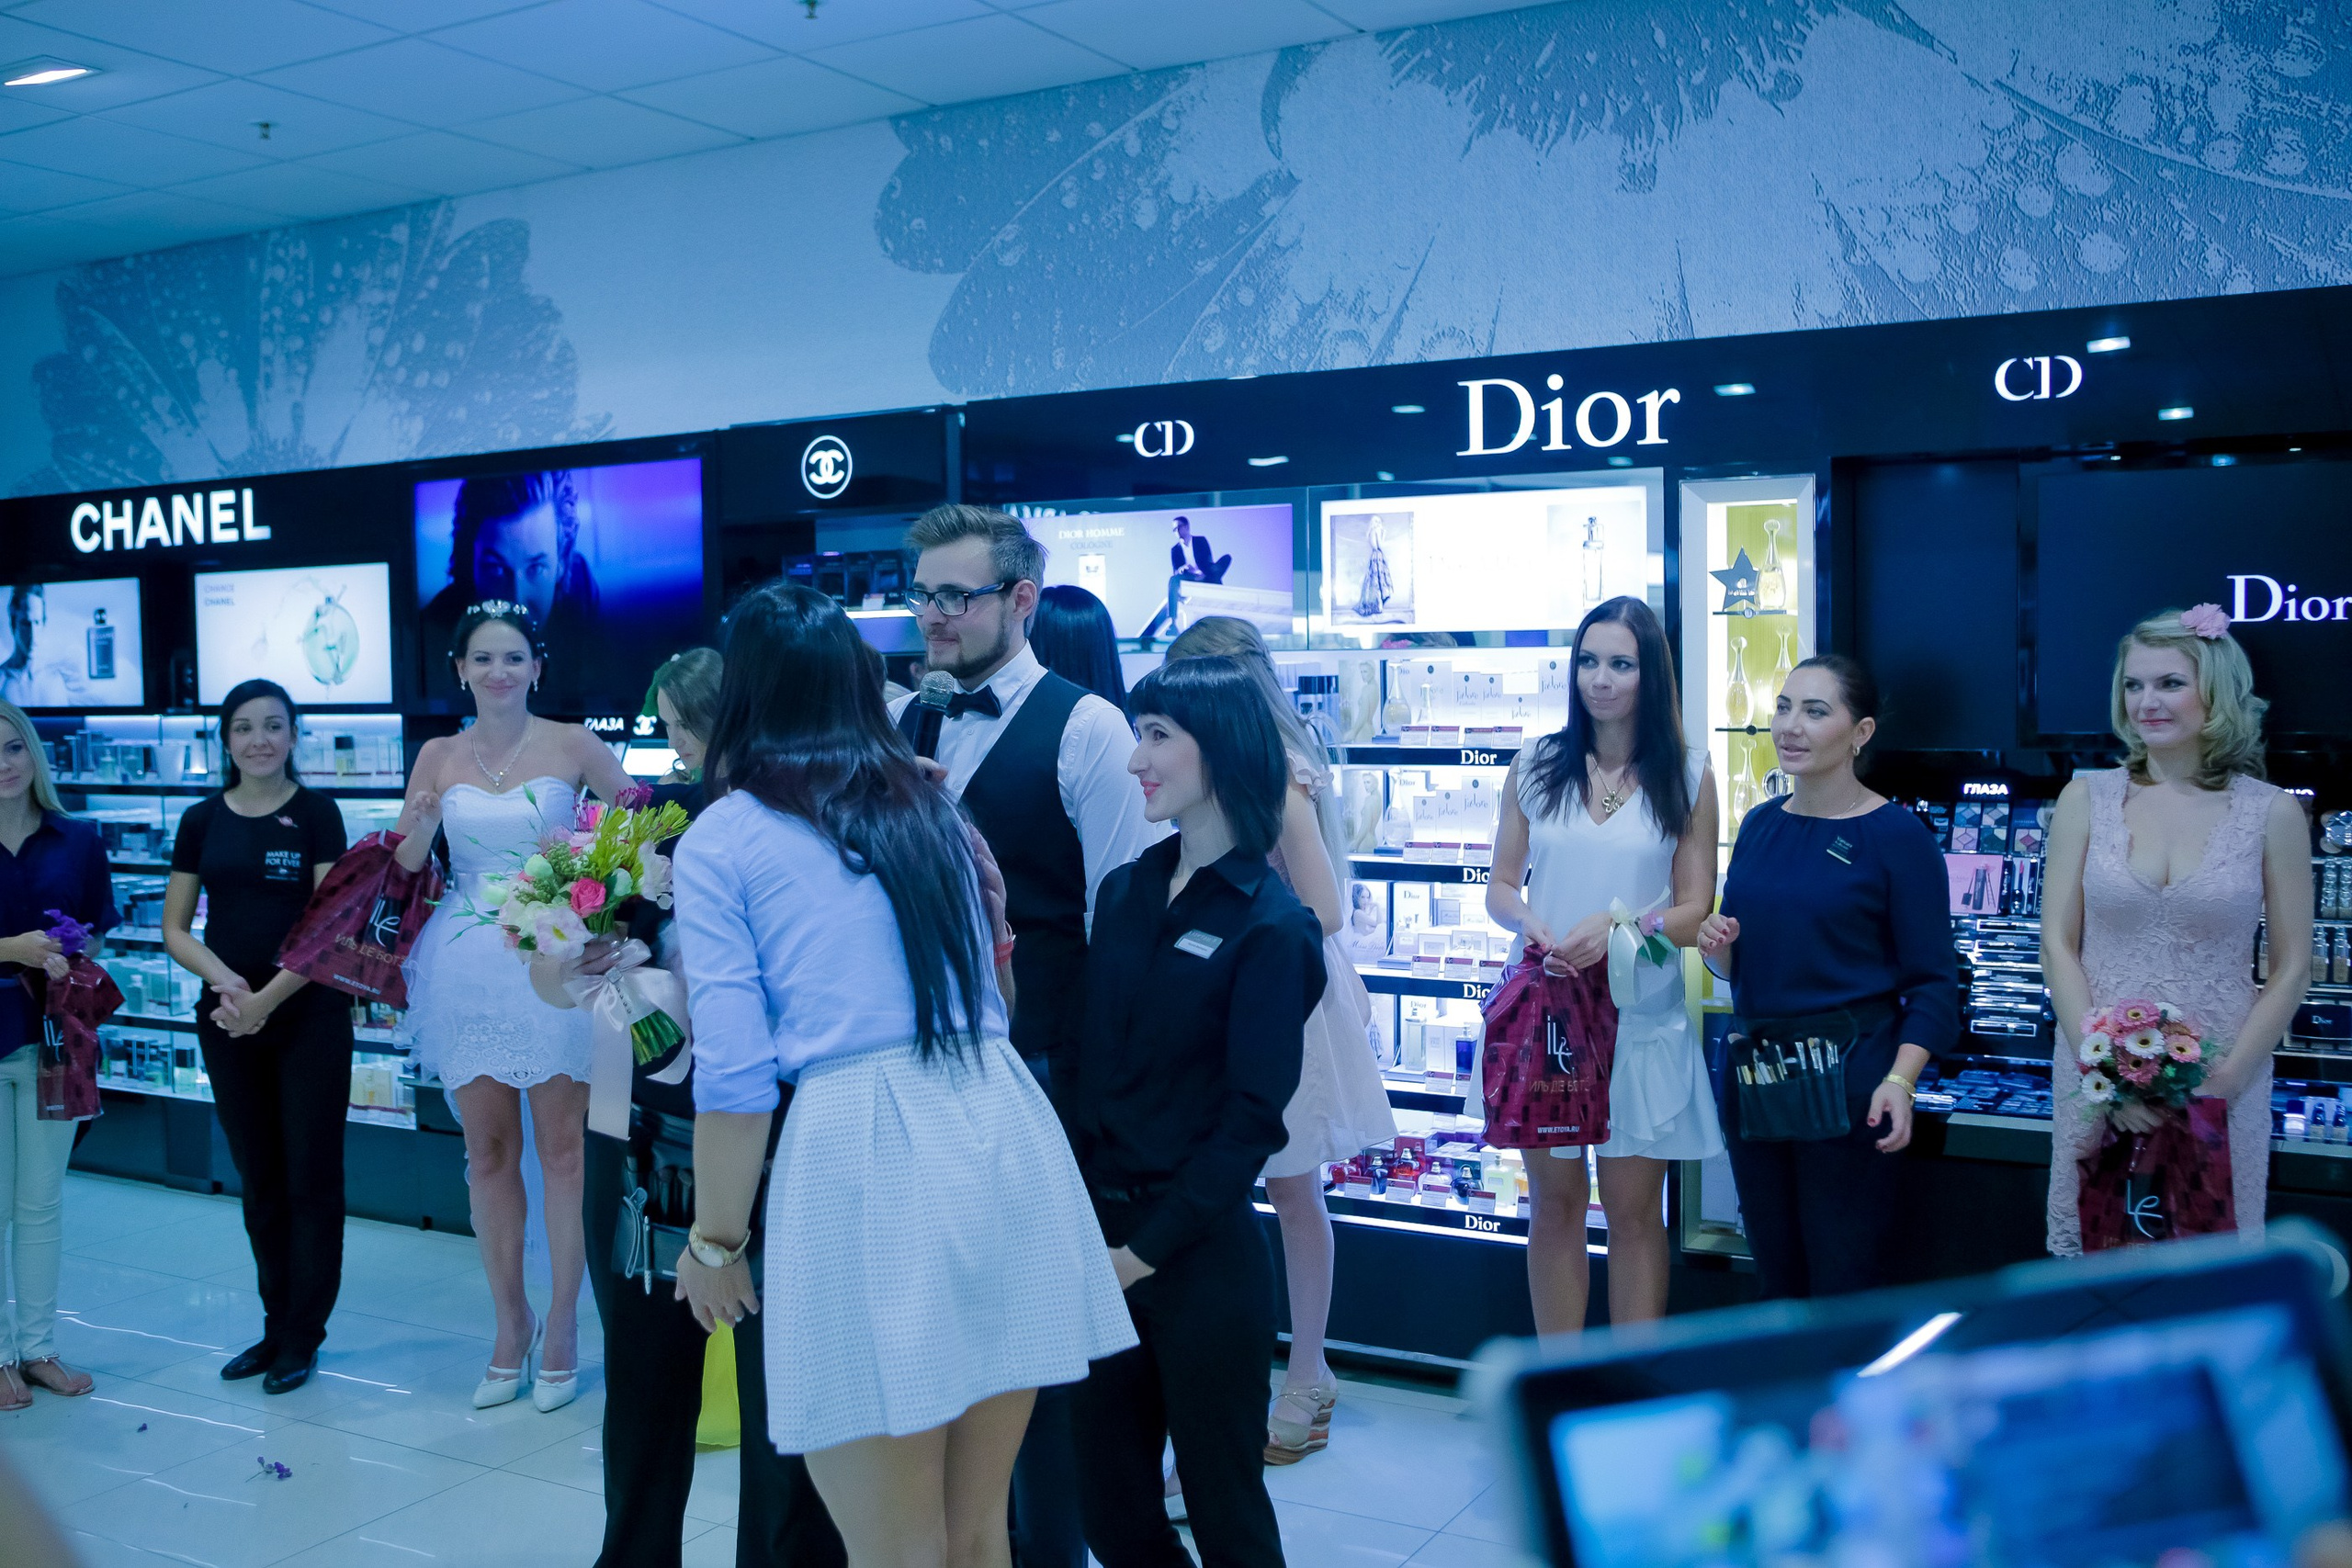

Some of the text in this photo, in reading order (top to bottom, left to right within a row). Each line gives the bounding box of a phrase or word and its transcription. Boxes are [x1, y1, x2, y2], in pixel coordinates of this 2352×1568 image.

[1456, 373, 1681, 457] Dior
[71, 488, 272, 553] CHANEL
[1058, 527, 1125, 539] DIOR HOMME
[2226, 574, 2352, 623] Dior
[1461, 750, 1498, 765] Dior
[1963, 783, 2009, 795] ГЛАЗА
[266, 858, 300, 868] FOR EVER
[290, 852, 301, 860] UP
[1463, 867, 1490, 883] Dio
[1403, 890, 1420, 899] Dior
[1464, 983, 1491, 998] Dio
[1410, 1000, 1427, 1009] Dior
[2312, 1015, 2333, 1025] Dior
[1529, 1080, 1549, 1093] ИЛЬ
[1551, 1080, 1565, 1094] ДЕ
[1464, 1214, 1501, 1232] Dior
